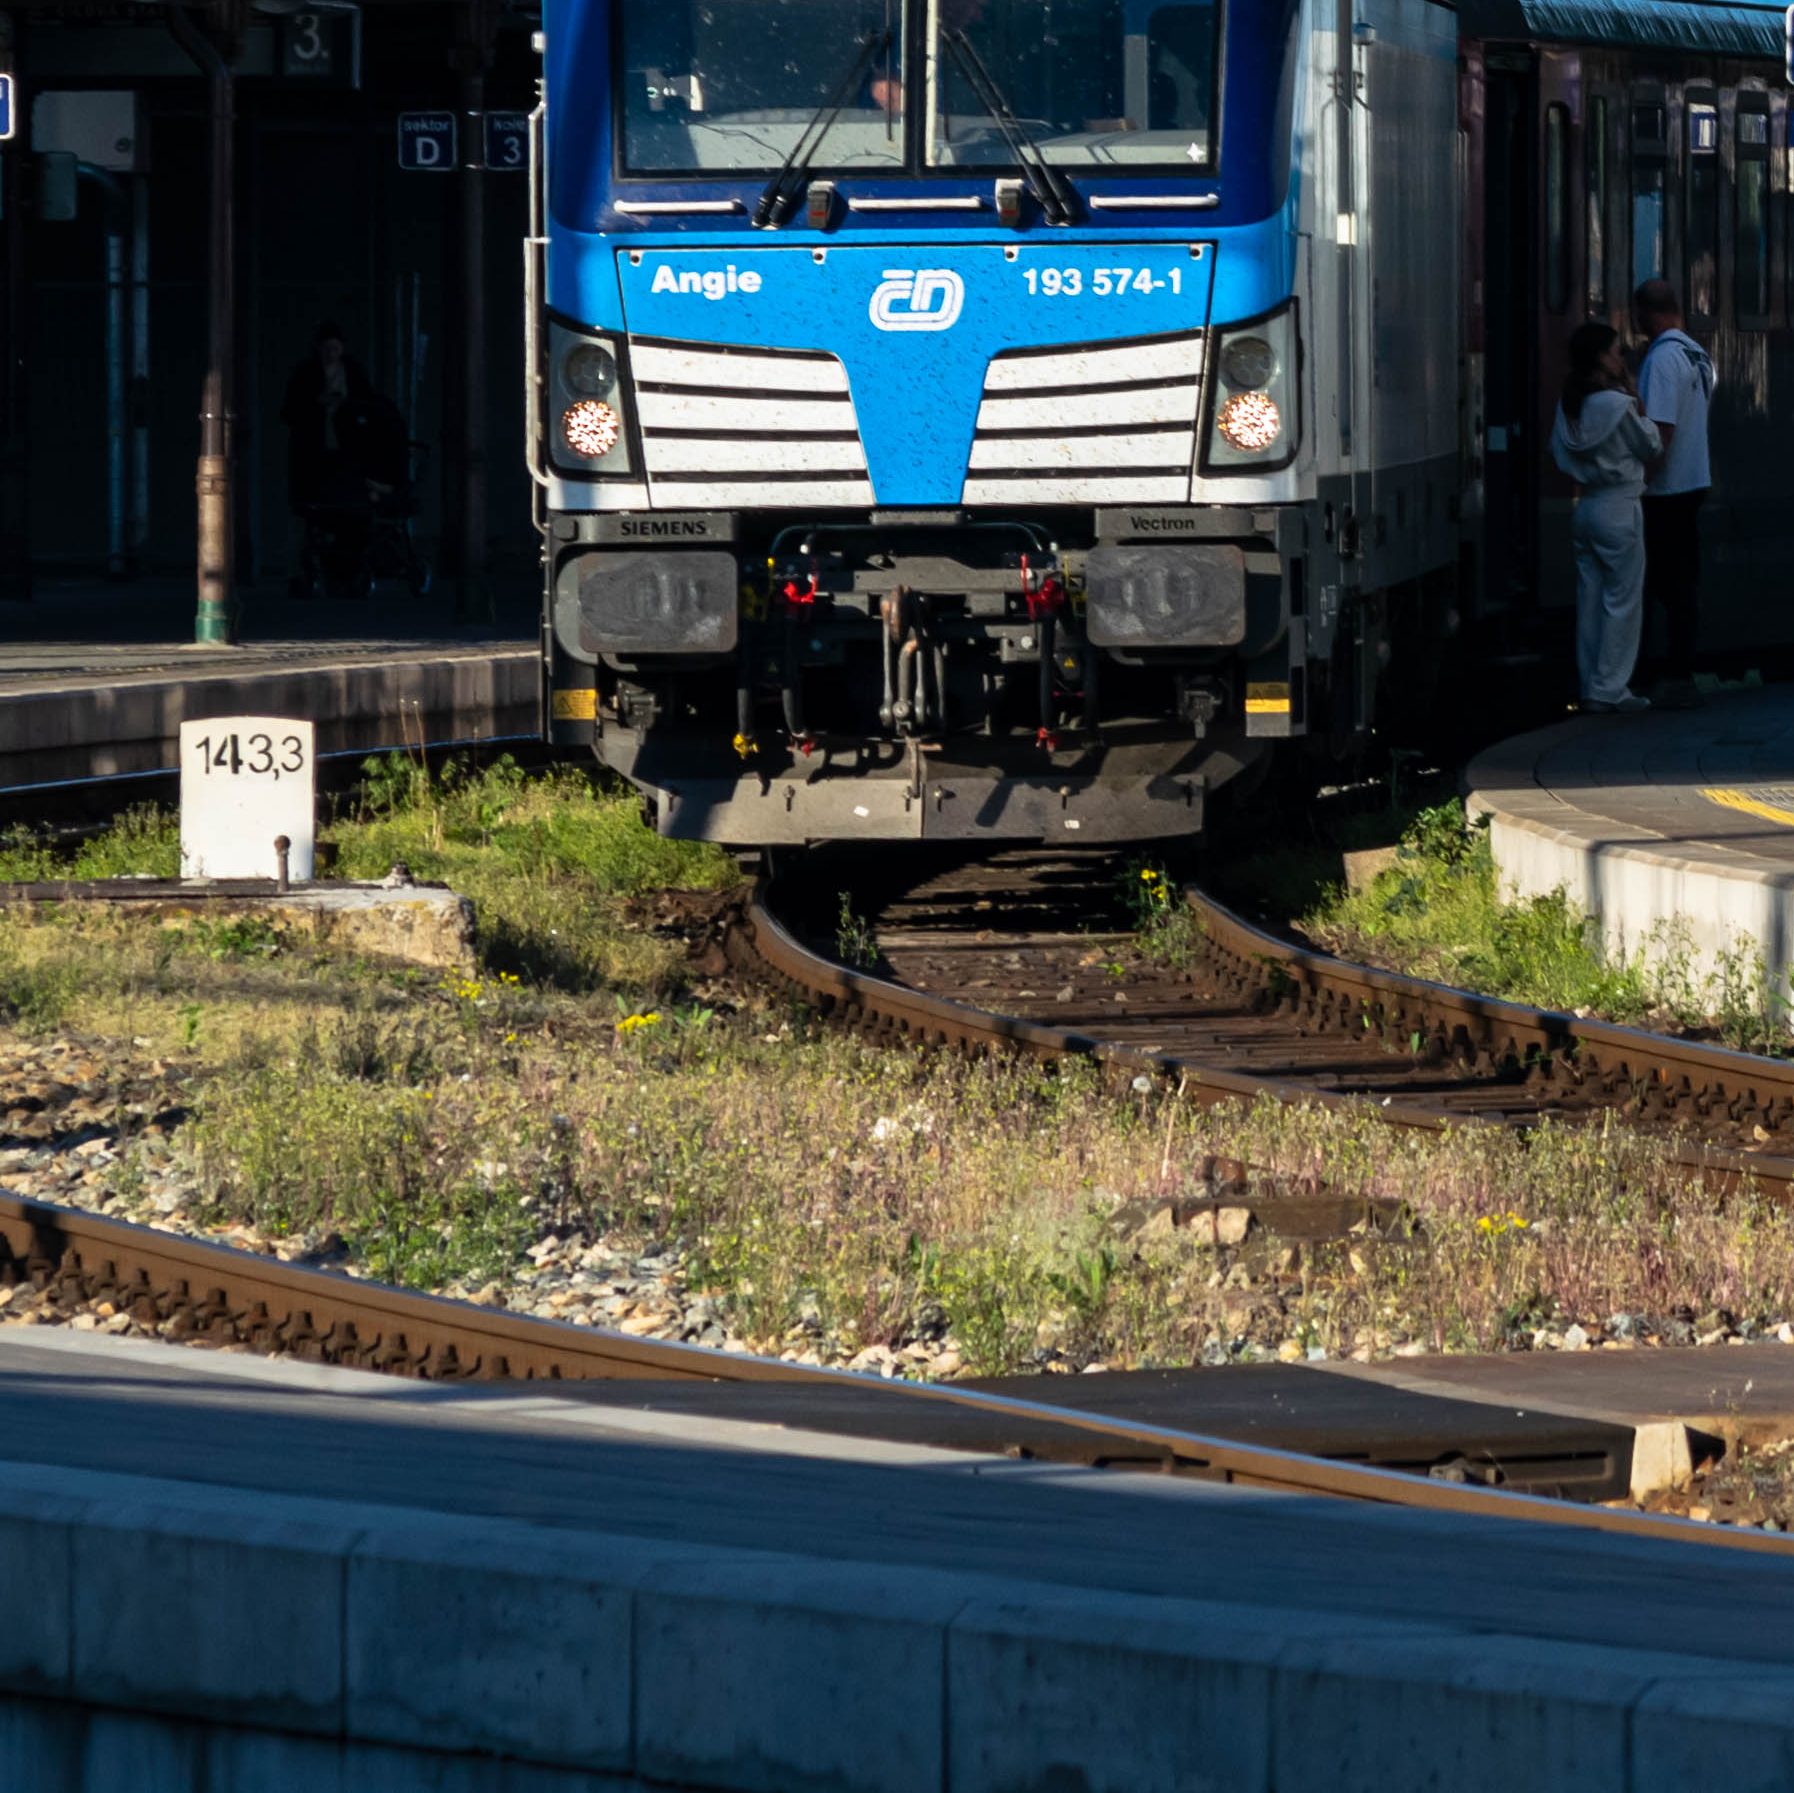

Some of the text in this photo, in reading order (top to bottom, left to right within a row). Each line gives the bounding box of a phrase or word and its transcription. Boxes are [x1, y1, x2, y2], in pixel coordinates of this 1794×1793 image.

[403, 118, 449, 133] sektor
[493, 117, 527, 133] kole
[415, 135, 441, 166] D
[503, 135, 521, 165] 3
[650, 265, 763, 301] Angie
[1022, 267, 1182, 297] 193 574-1
[620, 518, 708, 536] SIEMENS
[1130, 514, 1196, 532] Vectron
[195, 733, 305, 781] 143,3
